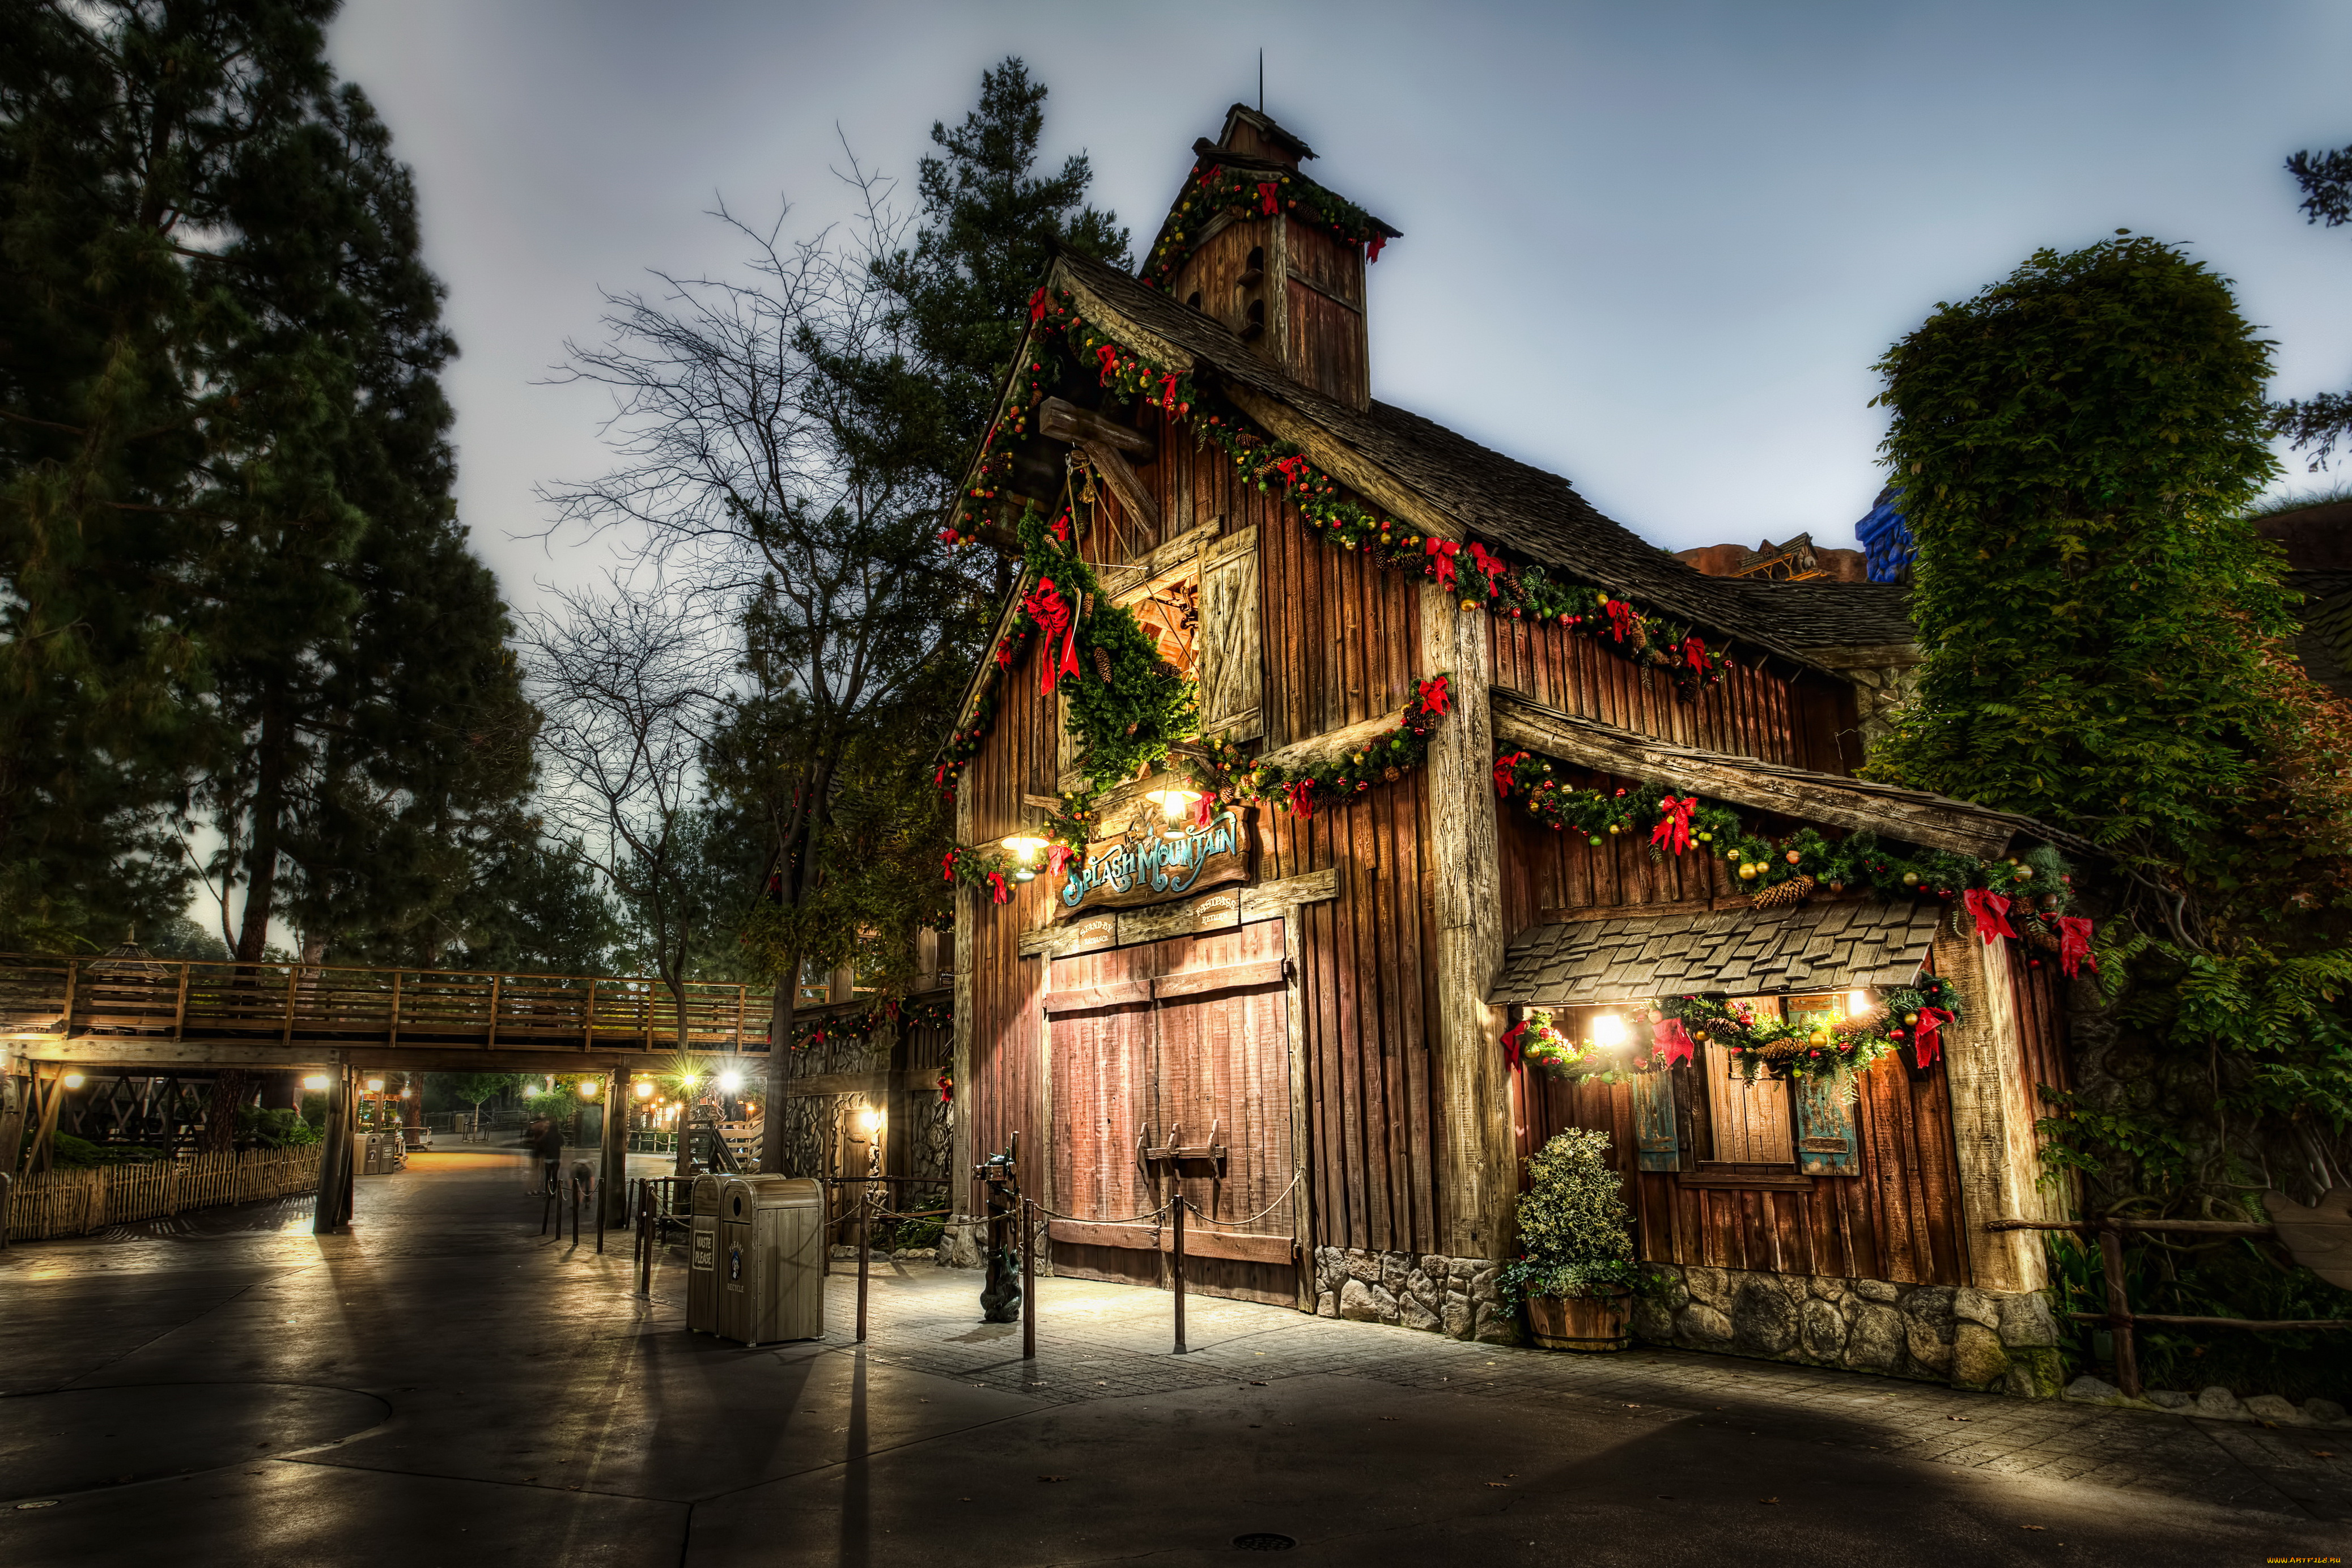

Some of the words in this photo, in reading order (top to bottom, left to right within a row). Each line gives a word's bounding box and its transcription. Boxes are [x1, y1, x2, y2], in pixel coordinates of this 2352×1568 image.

[1192, 896, 1237, 917] FASTPASS
[1202, 911, 1228, 925] RETURN
[1080, 921, 1113, 937] STAND-BY
[697, 1236, 711, 1249] WASTE
[729, 1241, 744, 1255] PLEASE
[695, 1251, 711, 1265] PLEASE
[727, 1283, 744, 1293] RECYCLE
